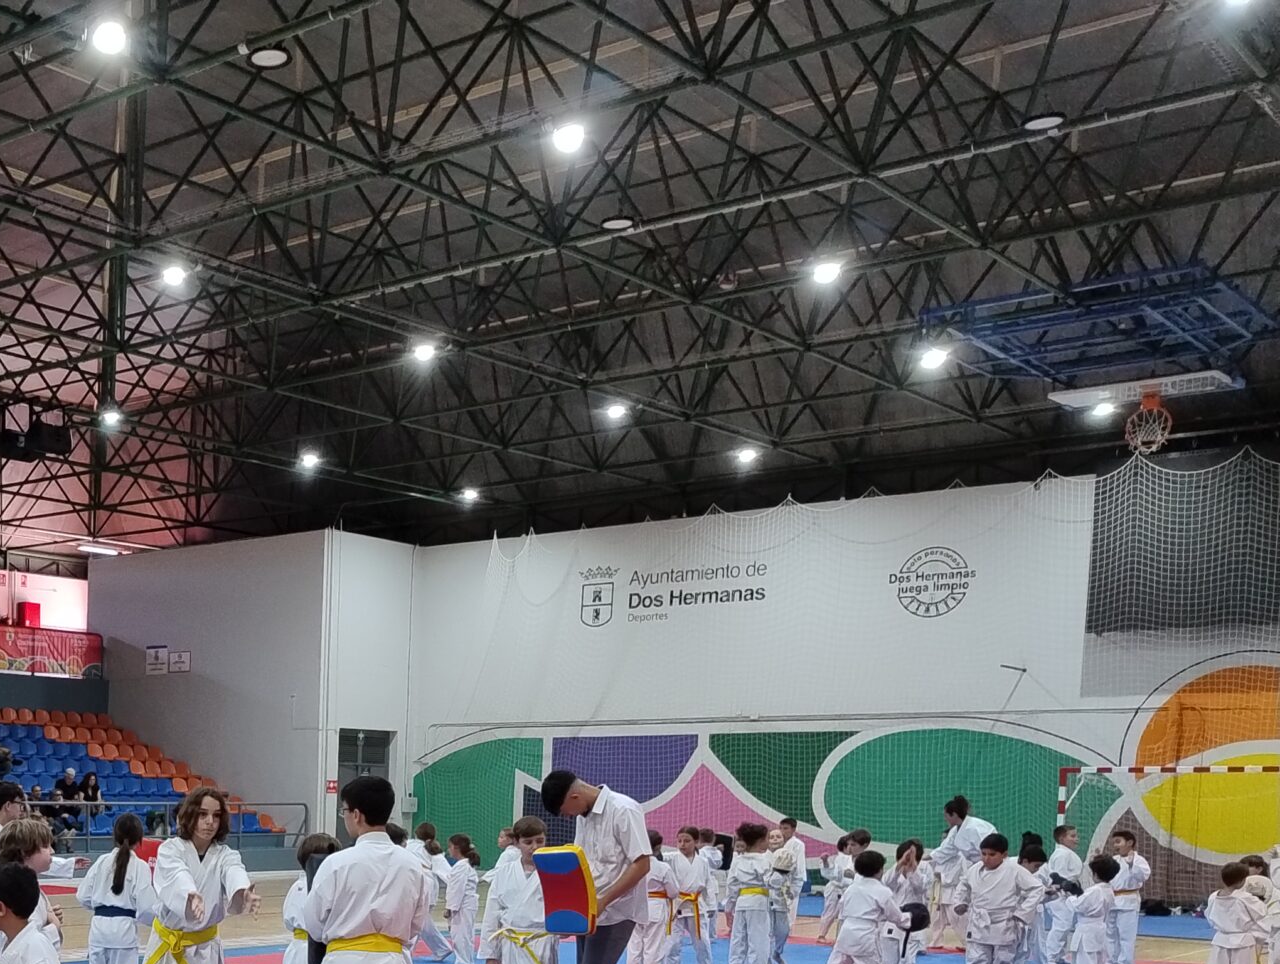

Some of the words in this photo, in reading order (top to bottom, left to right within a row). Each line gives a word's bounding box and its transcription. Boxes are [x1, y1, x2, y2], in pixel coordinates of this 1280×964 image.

[924, 550, 961, 568] personas
[629, 562, 740, 589] Ayuntamiento
[745, 560, 768, 577] de
[888, 573, 912, 584] Dos
[915, 570, 977, 583] Hermanas
[898, 583, 929, 595] juega
[933, 581, 970, 594] limpio
[628, 592, 664, 609] Dos
[669, 587, 766, 606] Hermanas
[627, 612, 669, 624] Deportes
